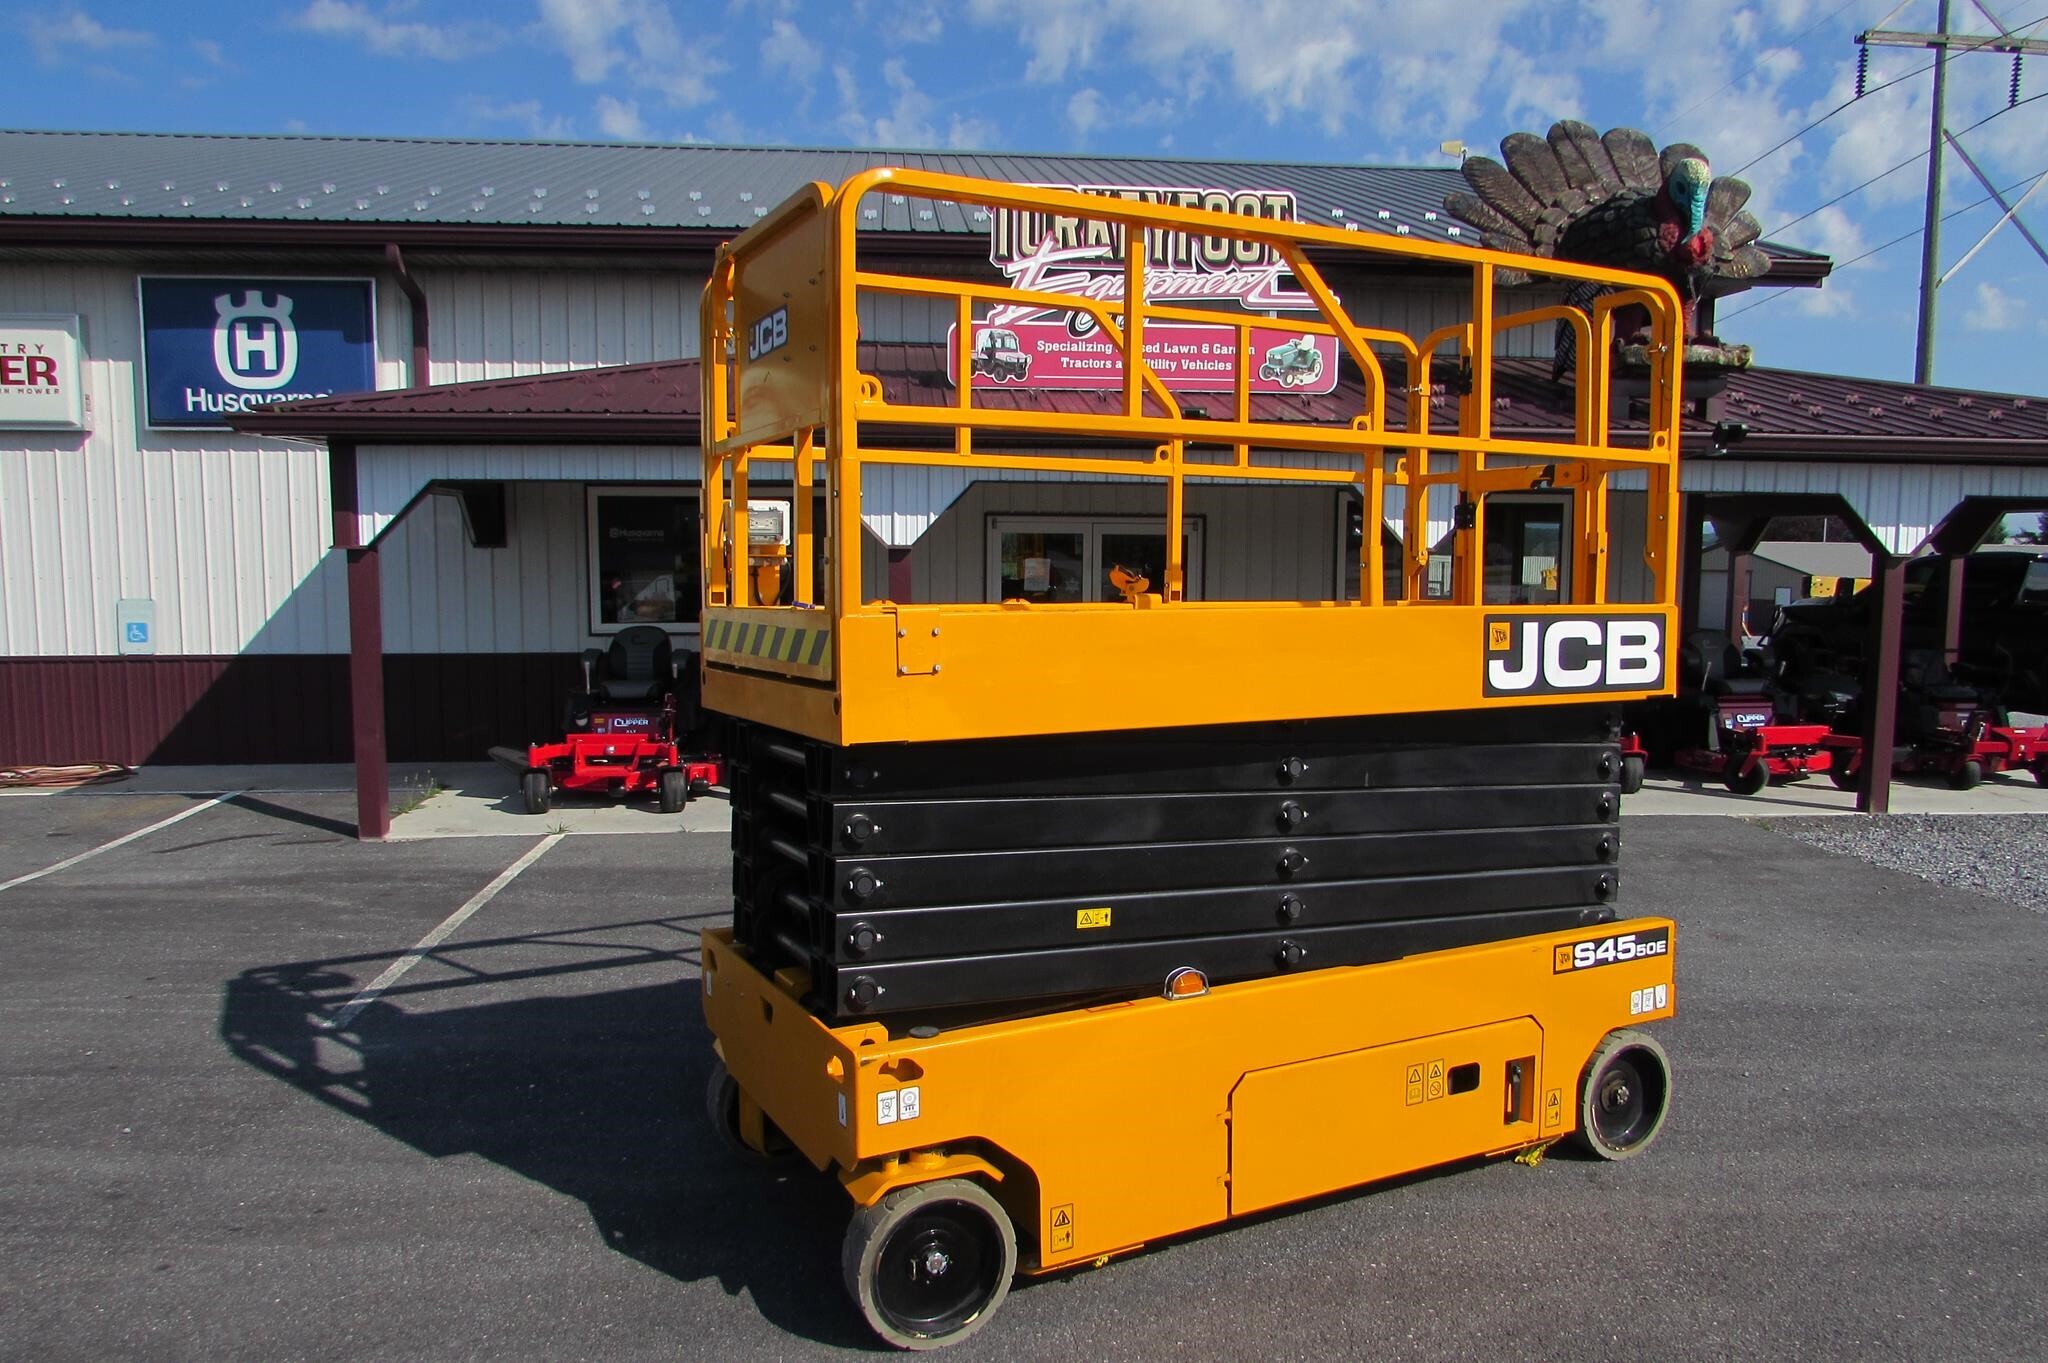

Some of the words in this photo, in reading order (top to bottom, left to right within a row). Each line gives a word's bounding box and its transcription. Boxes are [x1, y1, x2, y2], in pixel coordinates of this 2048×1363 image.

[750, 309, 787, 360] JCB
[1037, 340, 1113, 354] Specializing
[1141, 342, 1160, 353] sed
[1164, 343, 1197, 353] Lawn
[1201, 343, 1210, 354] &
[1213, 344, 1256, 355] Garn
[1061, 357, 1112, 368] Tractors
[1181, 360, 1232, 371] Vehicles
[186, 387, 329, 413] Husqv
[1488, 620, 1661, 690] JCB
[614, 718, 649, 727] CLIPPER
